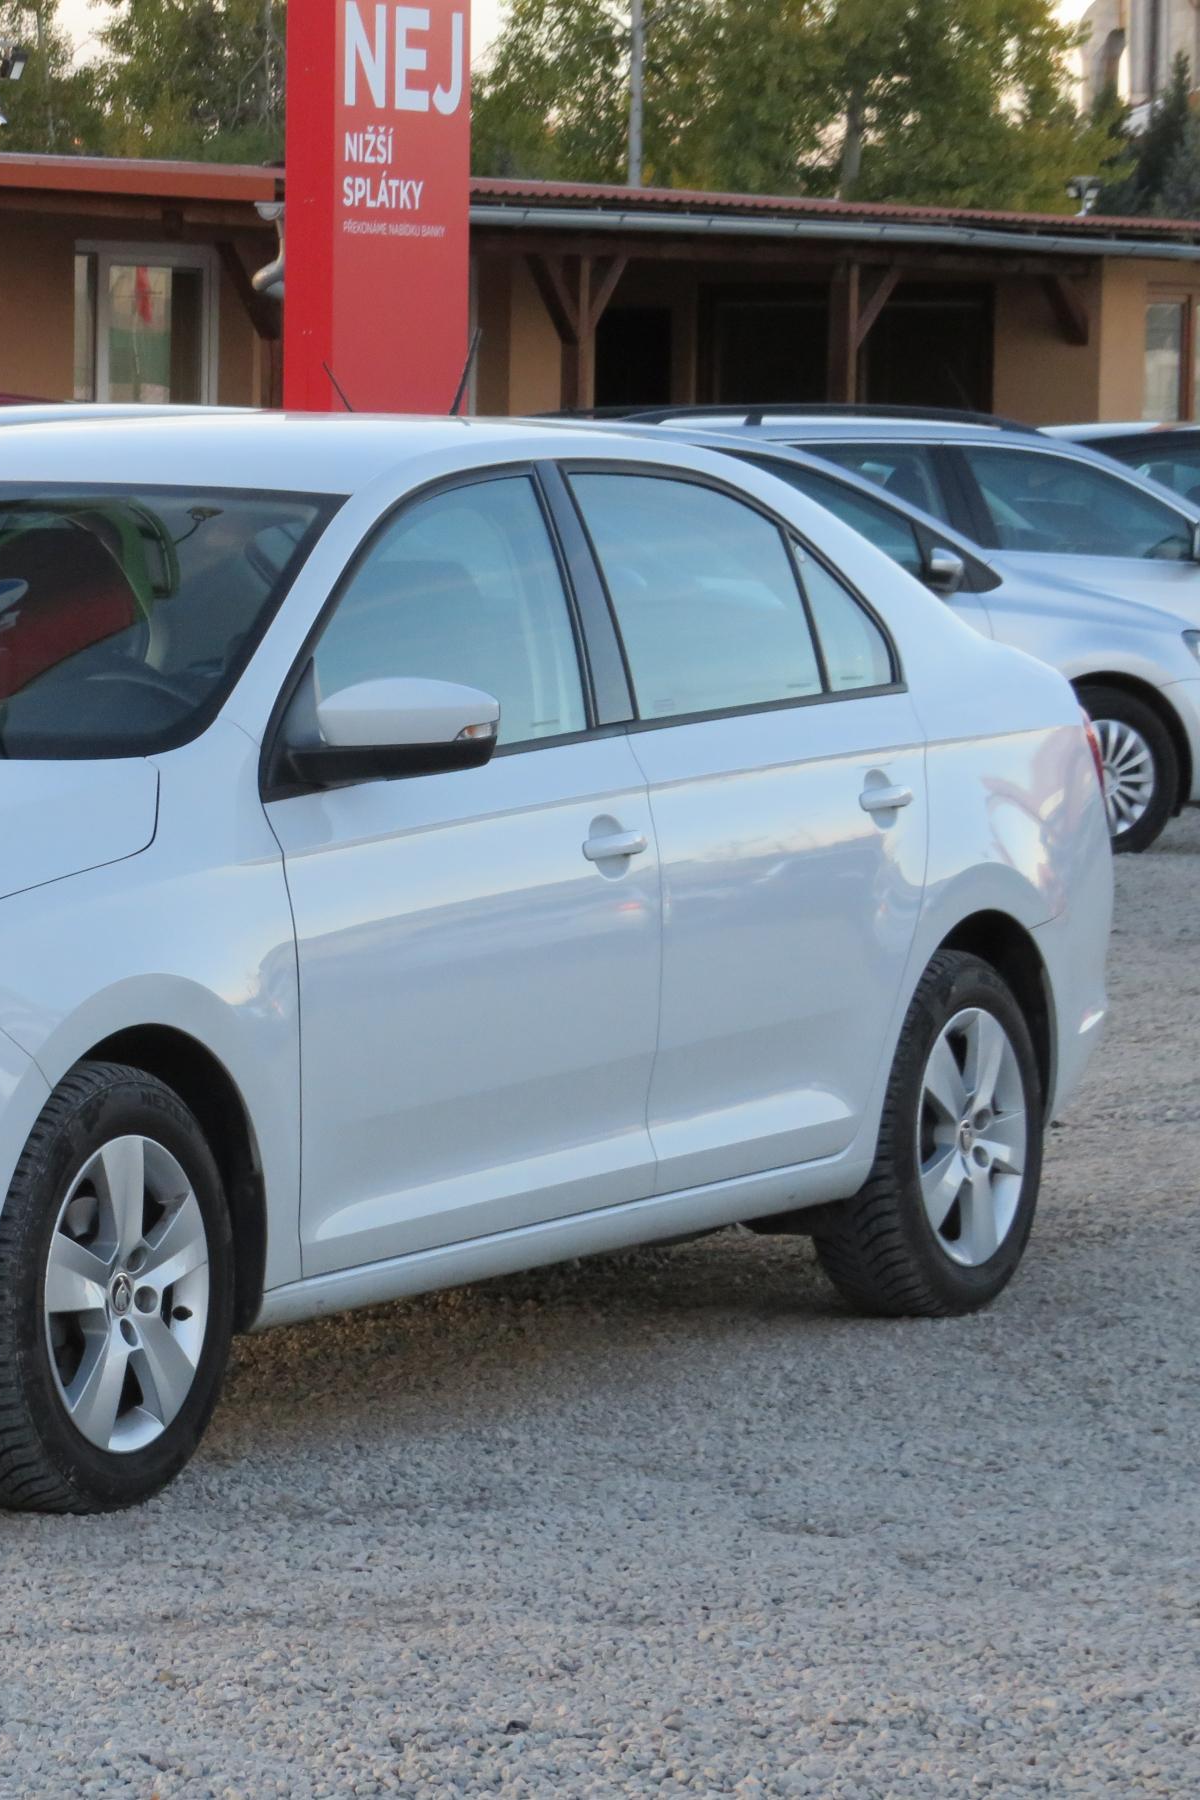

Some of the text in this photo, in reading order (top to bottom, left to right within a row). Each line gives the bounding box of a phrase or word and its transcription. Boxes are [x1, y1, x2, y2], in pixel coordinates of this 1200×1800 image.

[344, 0, 463, 115] NEJ
[344, 126, 394, 164] NIŽŠÍ
[342, 171, 424, 210] SPLÁTKY
